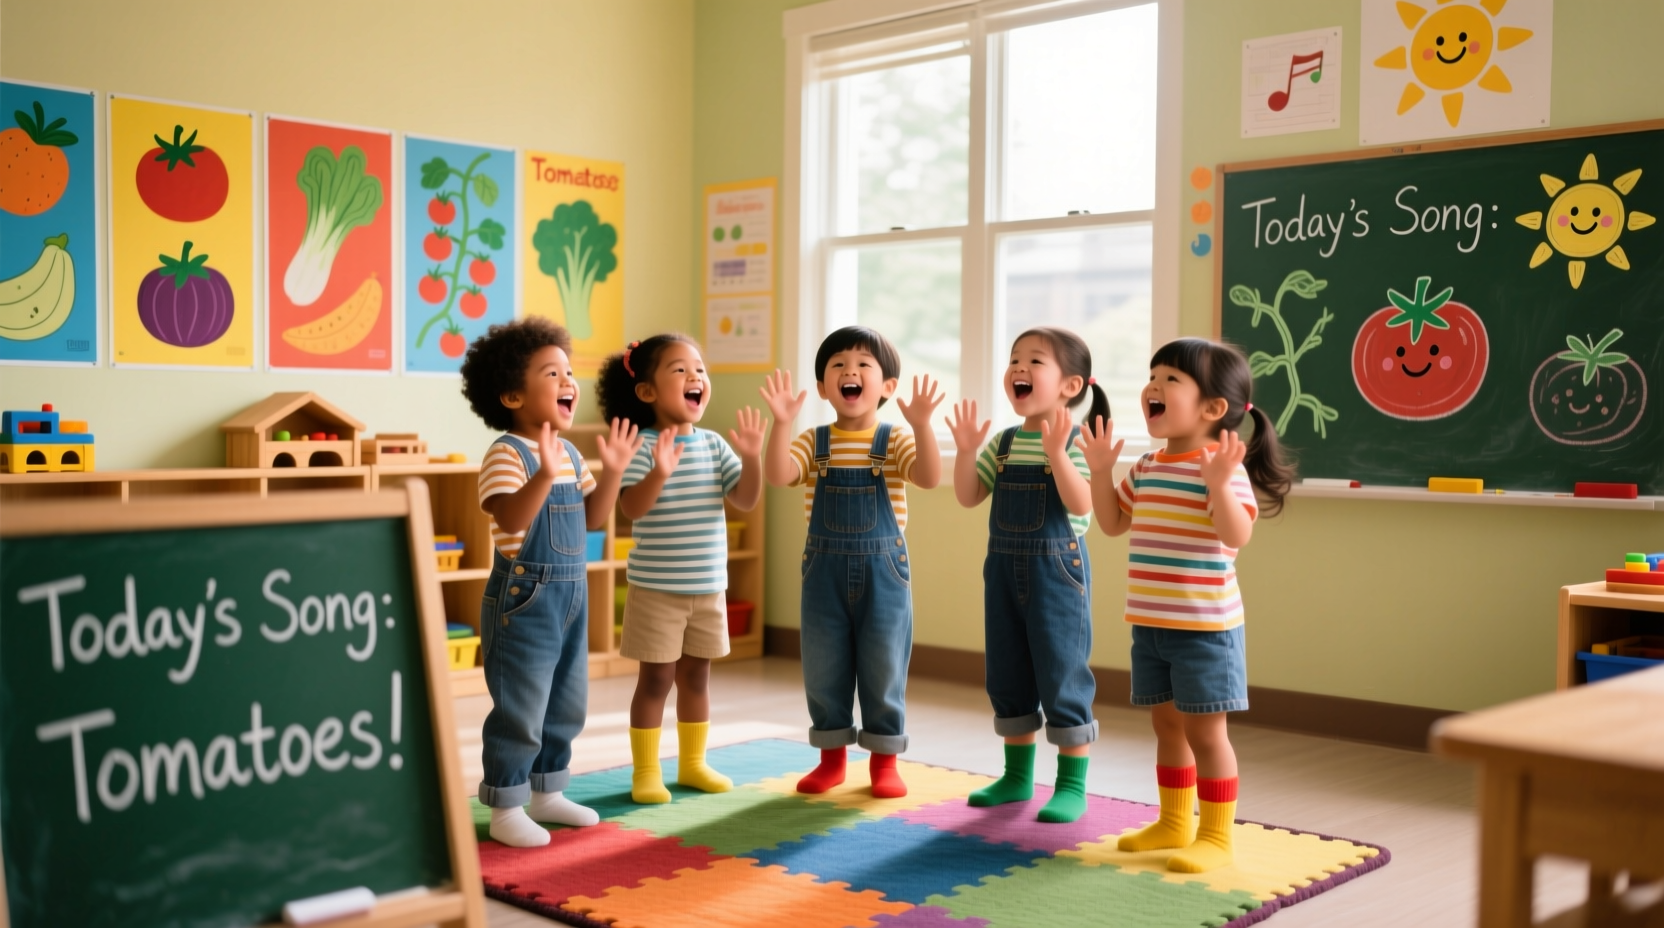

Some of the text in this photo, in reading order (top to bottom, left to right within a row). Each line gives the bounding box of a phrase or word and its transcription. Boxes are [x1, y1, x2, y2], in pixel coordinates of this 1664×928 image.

[1241, 185, 1499, 258] Today's Song:
[18, 568, 397, 684] Today's Song:
[36, 670, 404, 824] Tomatoes!
